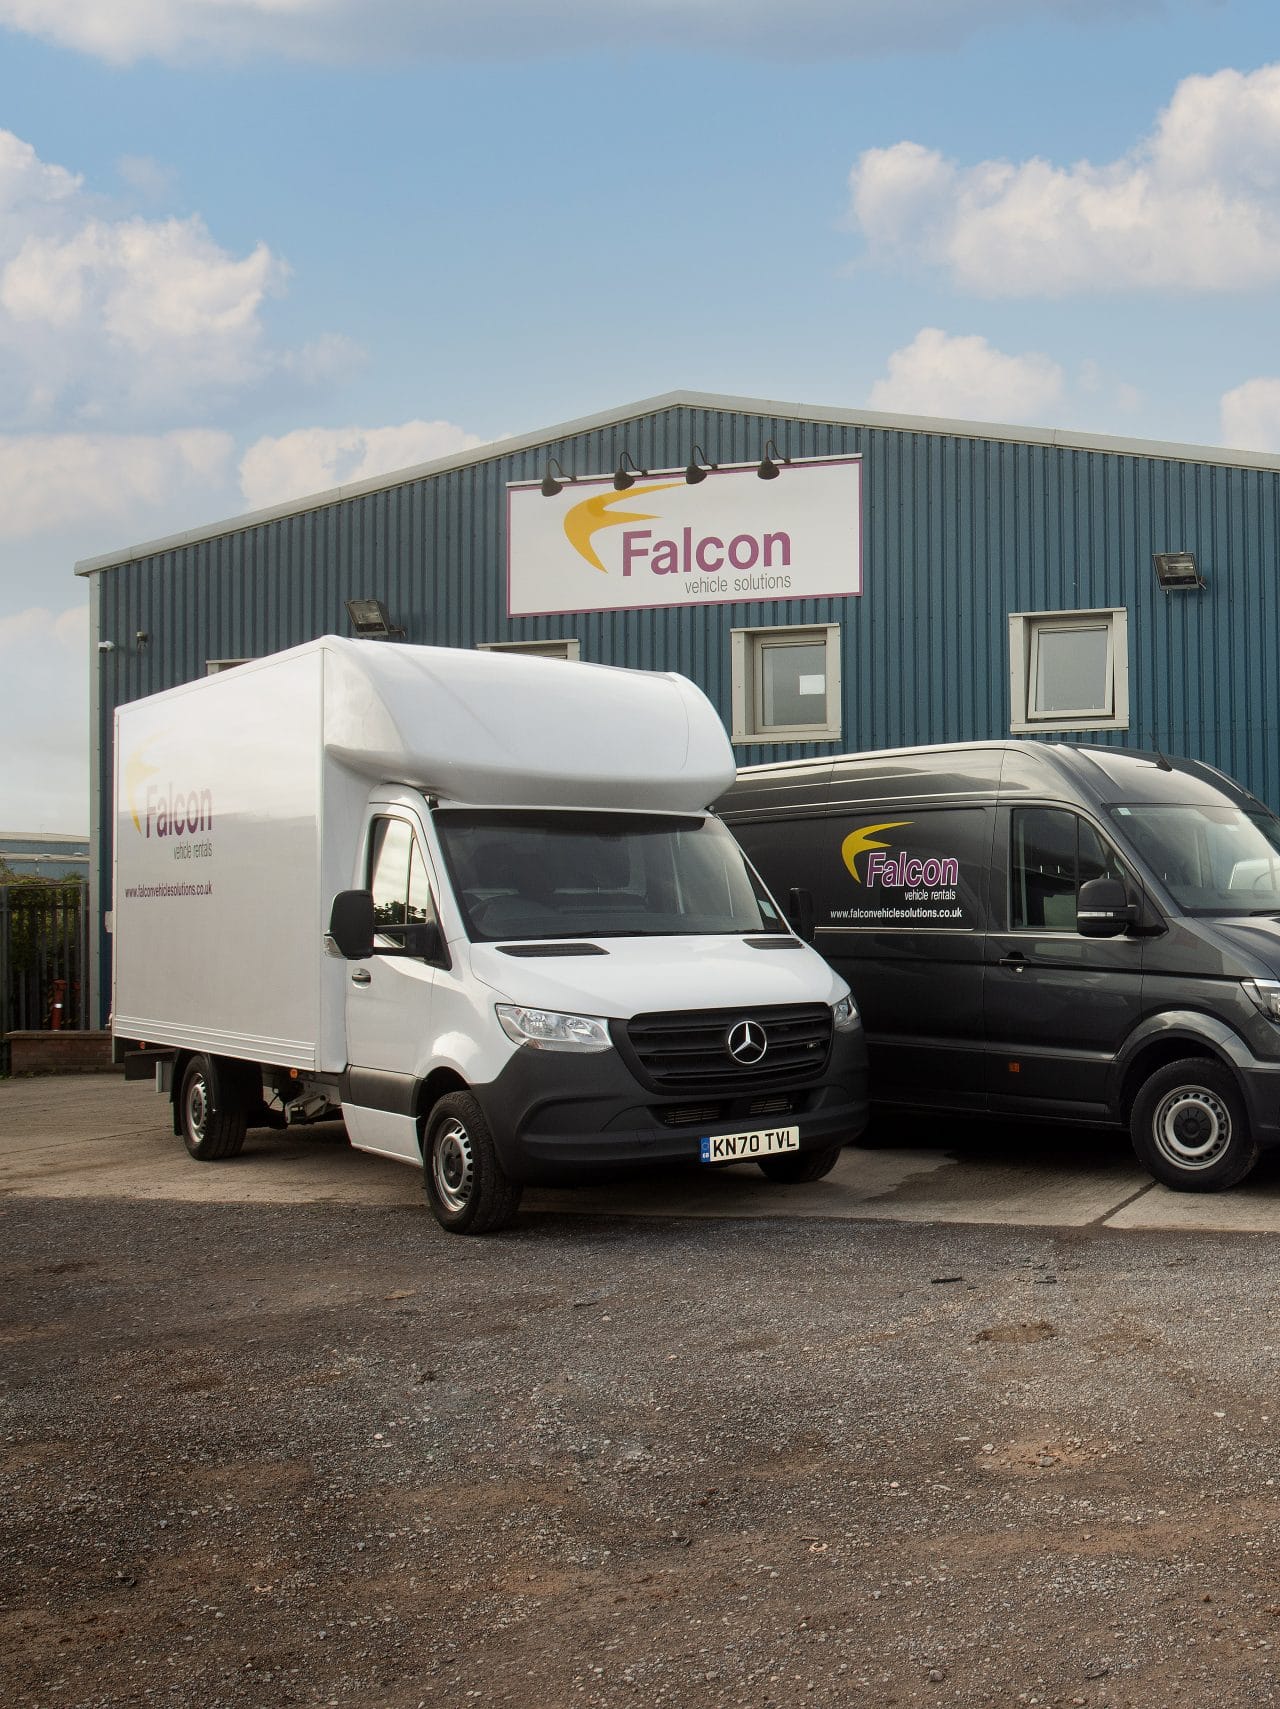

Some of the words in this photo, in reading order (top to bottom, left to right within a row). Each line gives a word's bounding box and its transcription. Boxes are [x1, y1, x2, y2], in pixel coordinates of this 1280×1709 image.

[622, 526, 791, 577] Falcon
[685, 575, 728, 594] vehicle
[734, 572, 792, 592] solutions
[146, 782, 212, 838] Falcon
[174, 841, 192, 860] vehicle
[193, 839, 213, 859] rentals
[866, 851, 959, 888] Falcon
[125, 880, 213, 898] www.falconvehiclesolutions.co.uk
[904, 889, 929, 901] vehicle
[930, 888, 956, 900] rentals
[830, 907, 963, 918] www.falconvehiclesolutions.co.uk
[713, 1134, 760, 1158] KN70
[765, 1130, 796, 1149] TVL
